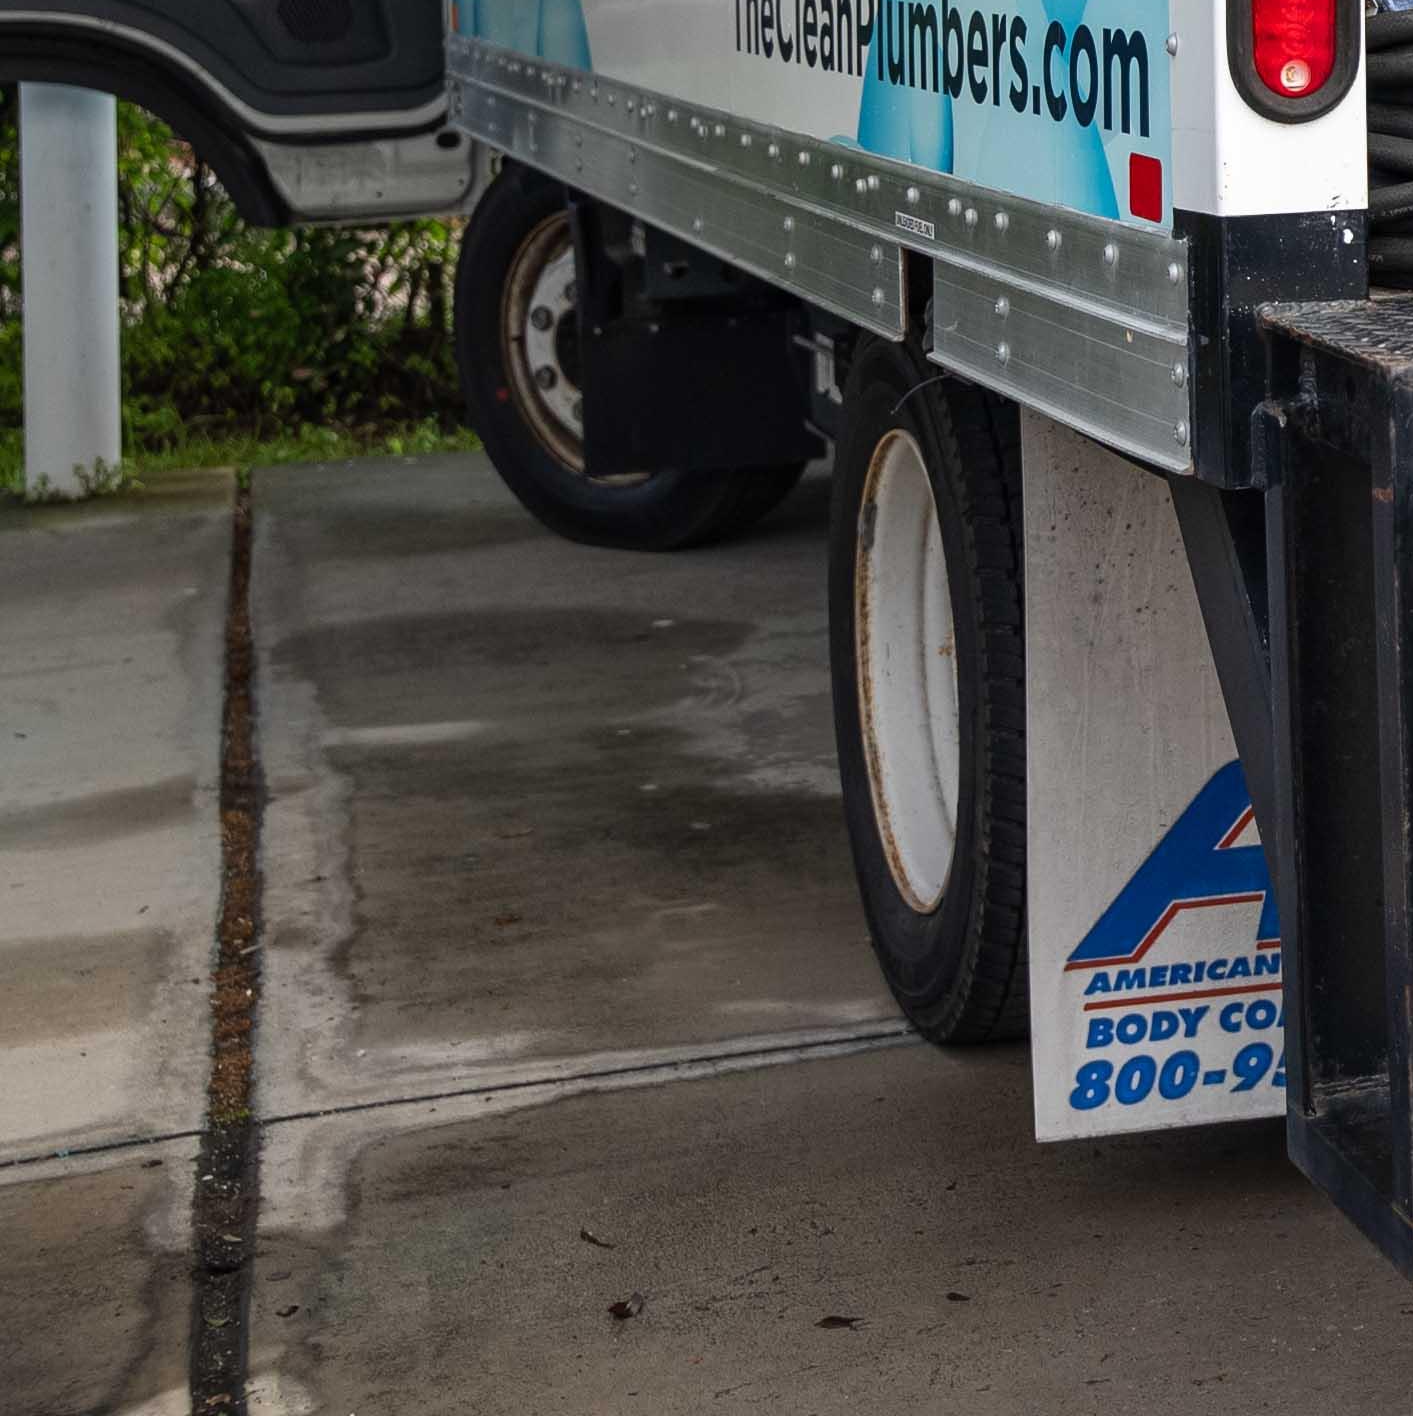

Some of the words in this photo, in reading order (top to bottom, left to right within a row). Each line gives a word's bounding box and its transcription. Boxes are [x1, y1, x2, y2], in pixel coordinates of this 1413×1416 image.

[1083, 951, 1282, 996] AMERICAN
[1086, 1005, 1211, 1050] BODY
[1219, 998, 1285, 1034] CO
